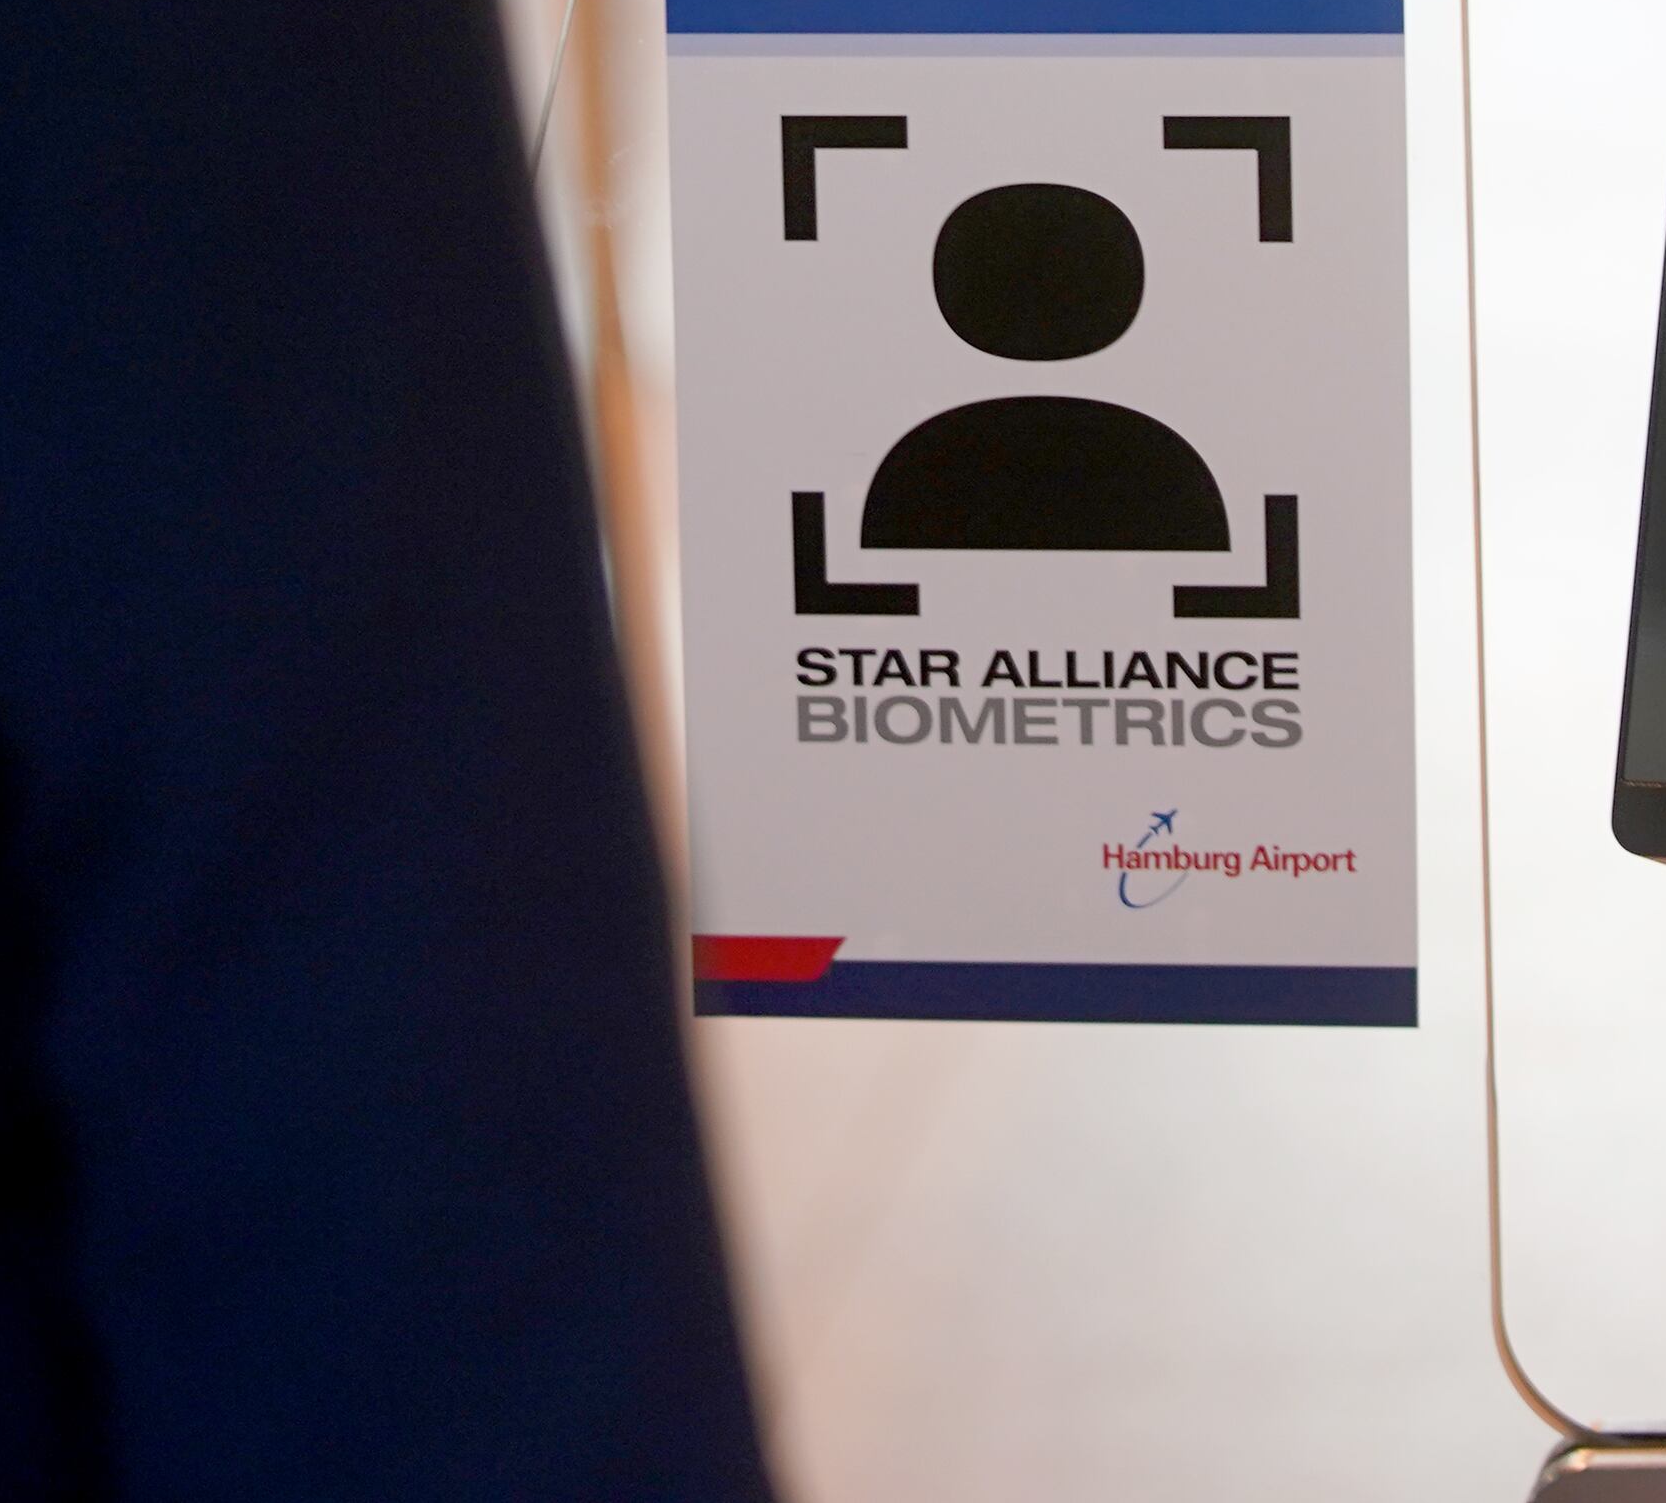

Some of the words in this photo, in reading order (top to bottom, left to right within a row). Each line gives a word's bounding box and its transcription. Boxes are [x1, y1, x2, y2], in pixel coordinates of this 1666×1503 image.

[796, 648, 962, 689] STAR
[982, 650, 1301, 692] ALLIANCE
[796, 694, 1304, 750] BIOMETRICS
[1102, 844, 1243, 880] Hamburg
[1250, 844, 1357, 879] Airport
